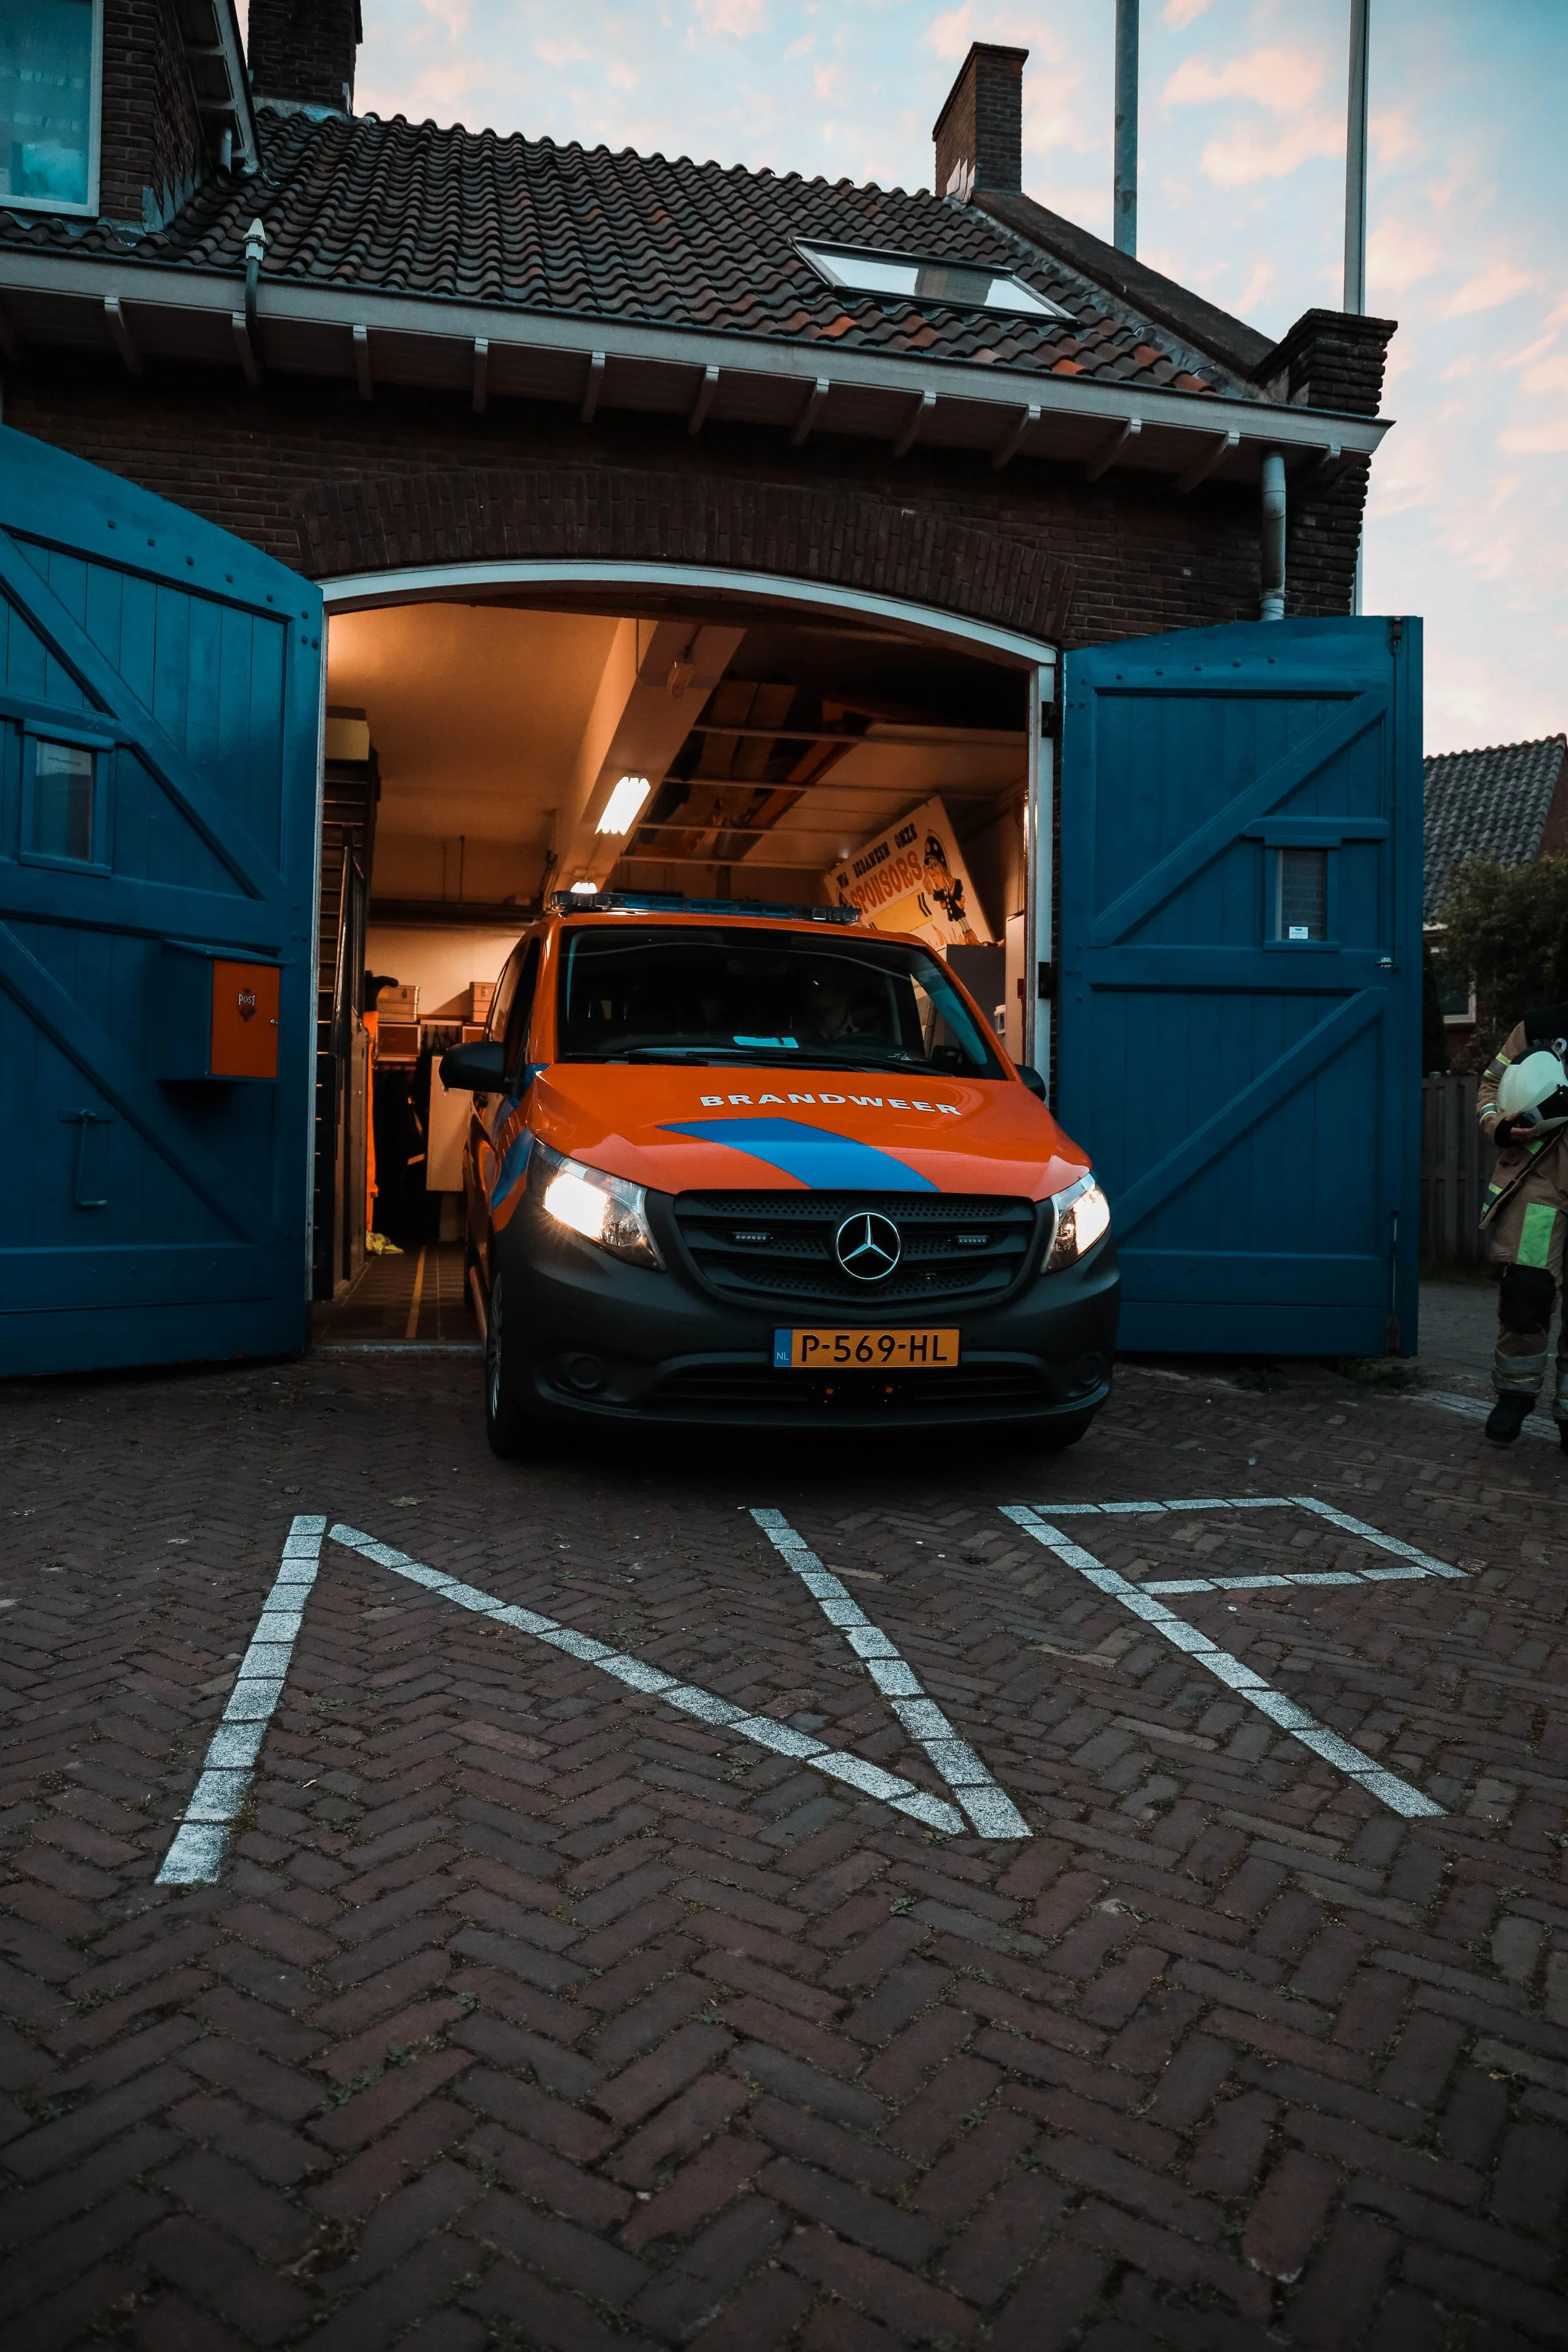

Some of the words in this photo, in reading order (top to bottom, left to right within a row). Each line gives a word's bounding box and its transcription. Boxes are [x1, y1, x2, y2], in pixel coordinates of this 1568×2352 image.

[894, 823, 918, 849] ONZE
[850, 850, 923, 914] SPONSORS
[699, 1093, 963, 1116] BRANDWEER
[776, 1352, 789, 1361] NL
[801, 1333, 948, 1363] P-569-HL
